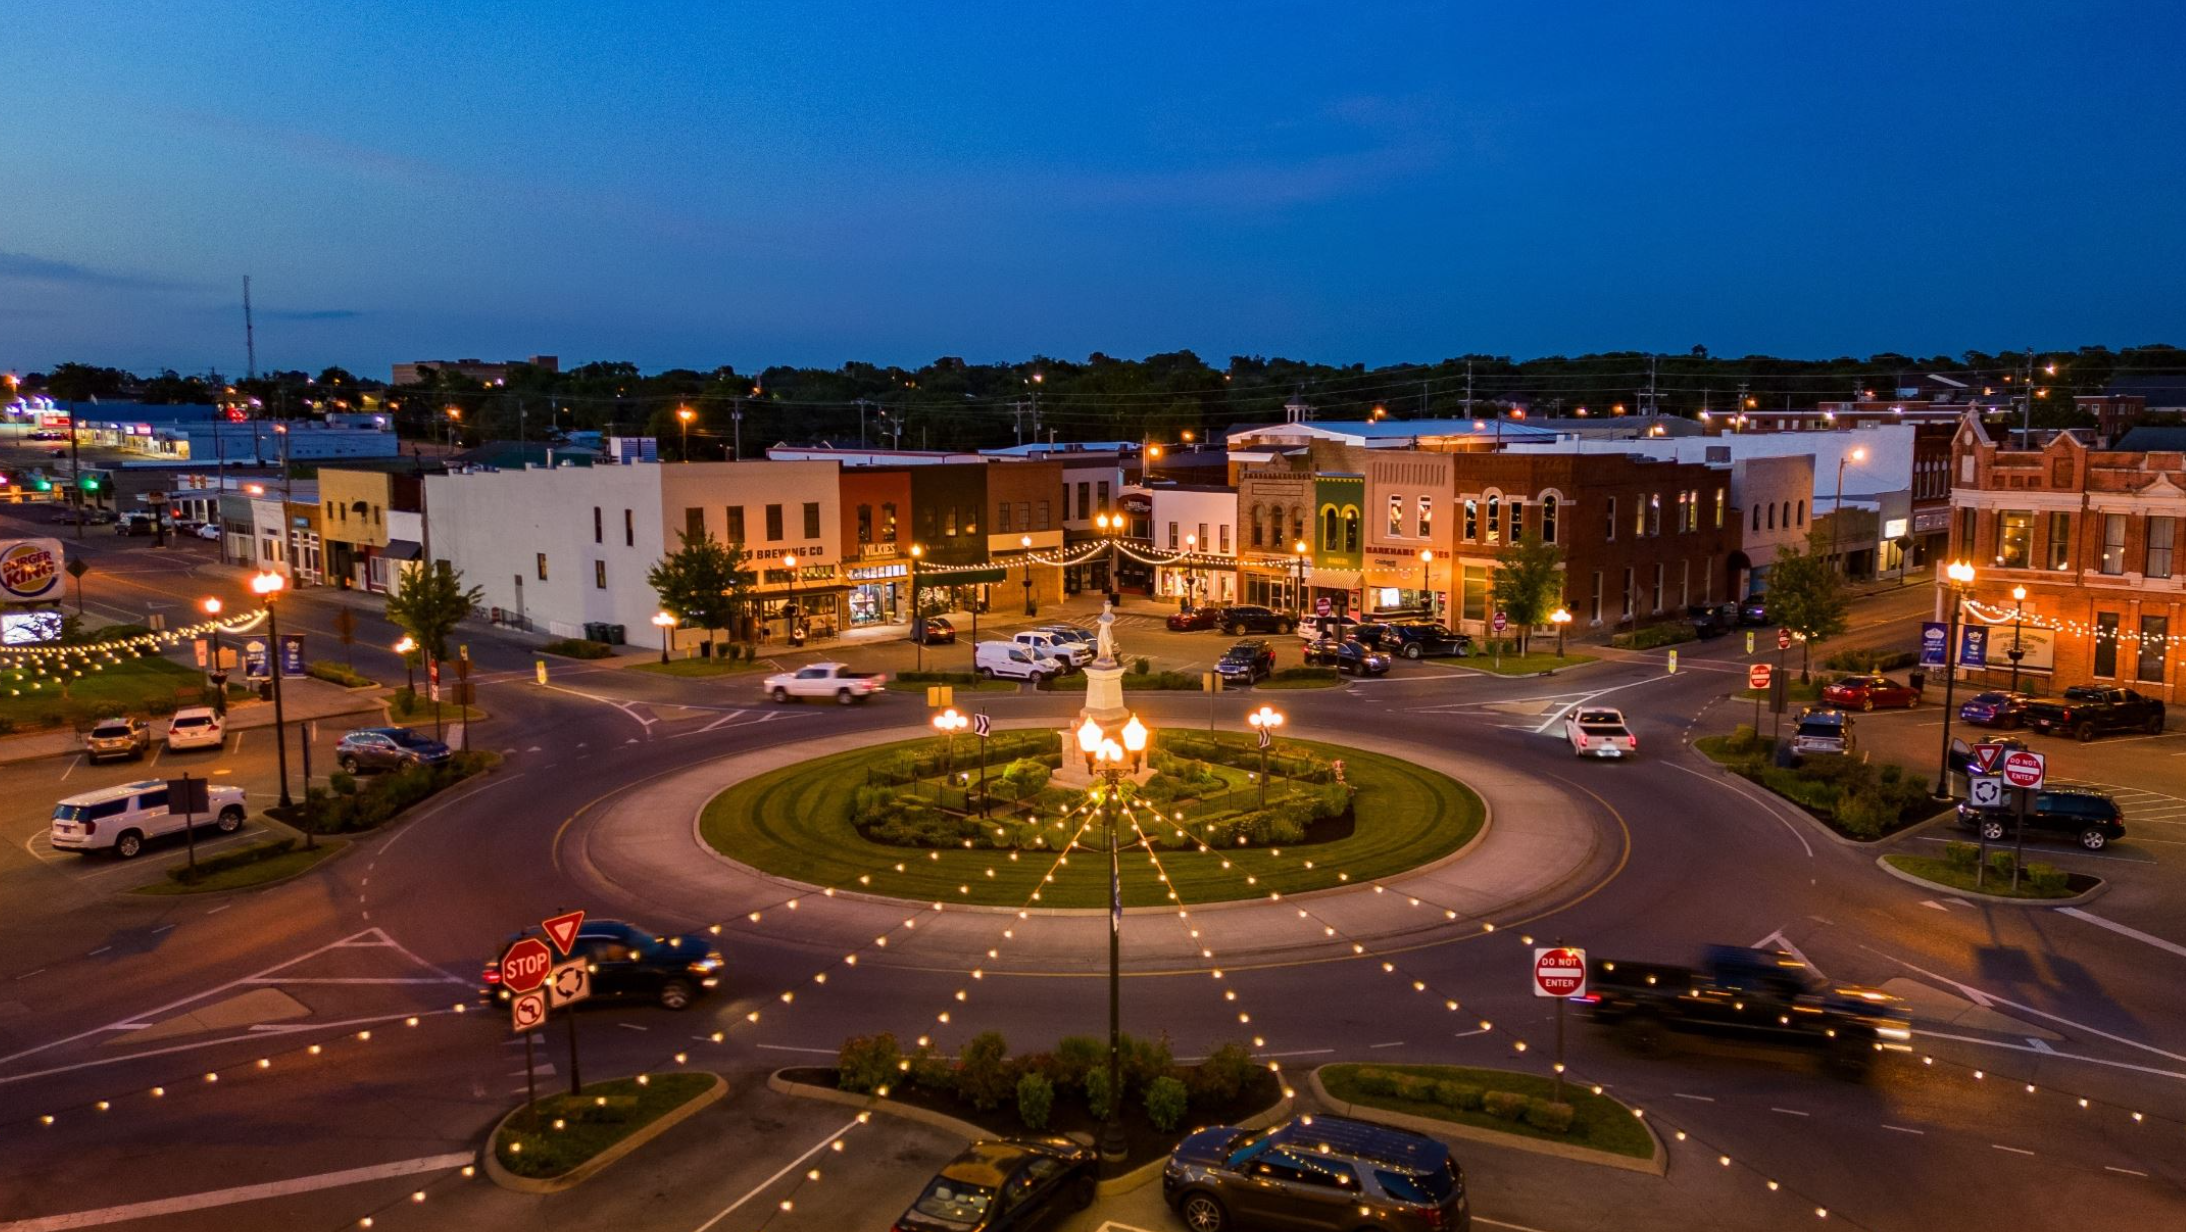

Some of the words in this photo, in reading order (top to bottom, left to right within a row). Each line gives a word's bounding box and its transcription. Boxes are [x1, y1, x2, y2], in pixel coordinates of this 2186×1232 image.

[757, 547, 807, 560] BREWING
[809, 546, 823, 556] CO
[864, 543, 896, 556] VILKIES
[1365, 546, 1415, 556] MARKHAMS
[2, 550, 52, 574] BURGER
[5, 560, 55, 588] KING
[2022, 759, 2037, 767] NOT
[2011, 772, 2034, 782] ENTER
[506, 952, 548, 980] STOP
[1541, 957, 1555, 966] DO
[1558, 958, 1578, 967] NOT
[1545, 978, 1575, 988] ENTER
